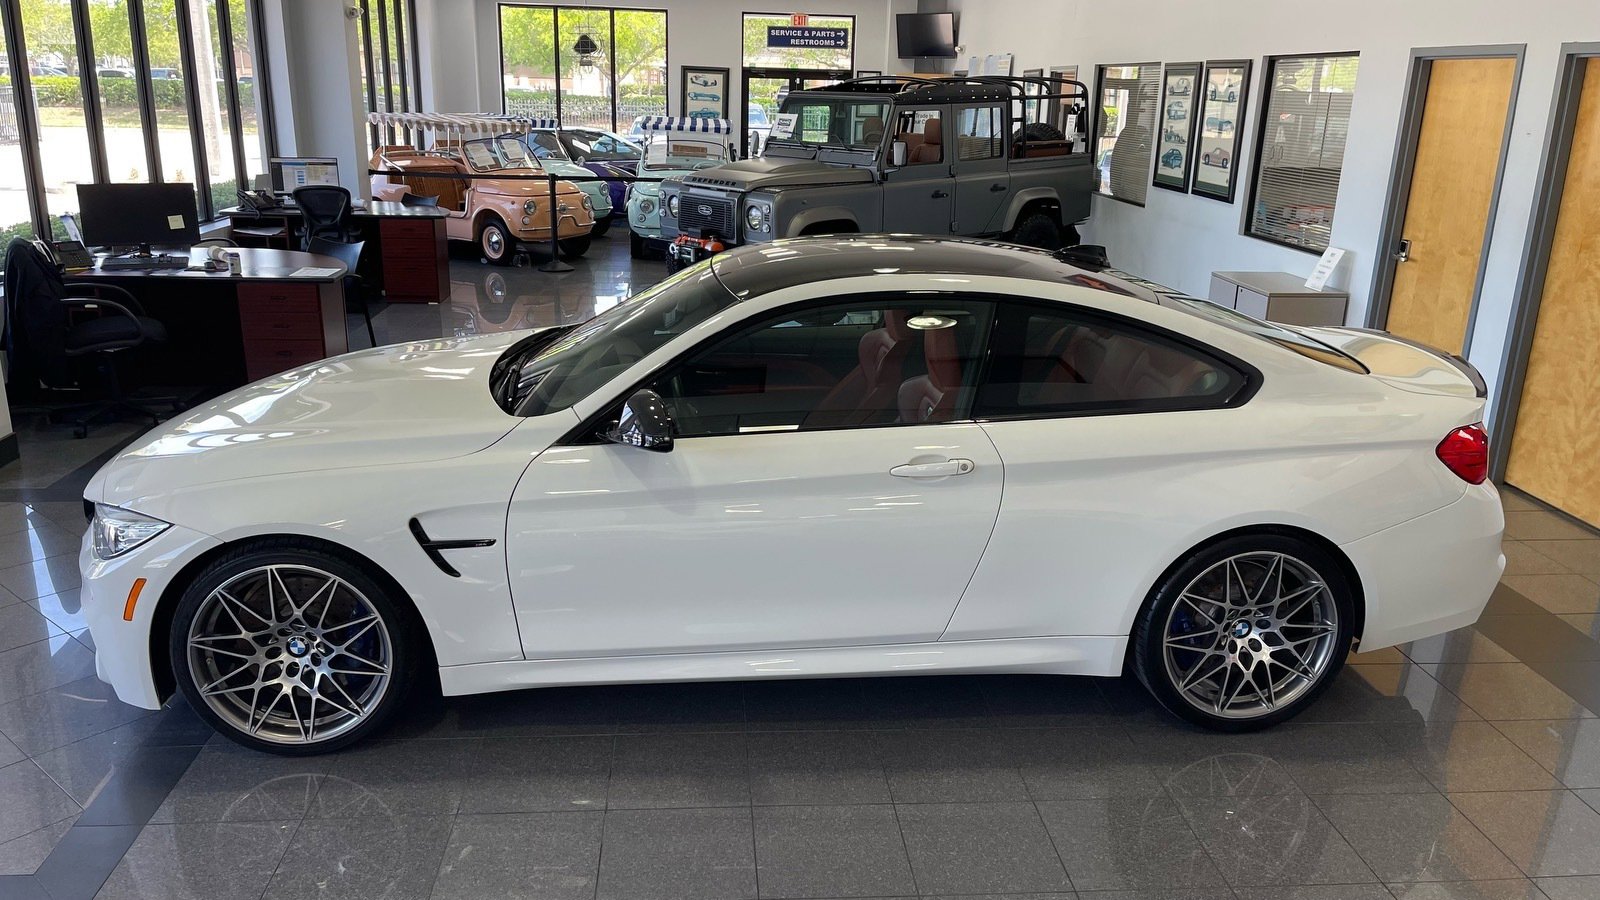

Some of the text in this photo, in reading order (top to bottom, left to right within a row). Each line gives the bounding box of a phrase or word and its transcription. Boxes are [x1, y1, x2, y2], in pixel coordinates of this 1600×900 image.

[794, 15, 806, 26] EXIT
[771, 29, 802, 37] SERVICE
[811, 30, 836, 38] PARTS
[790, 38, 835, 46] RESTROOMS
[691, 176, 737, 186] DEFENDER
